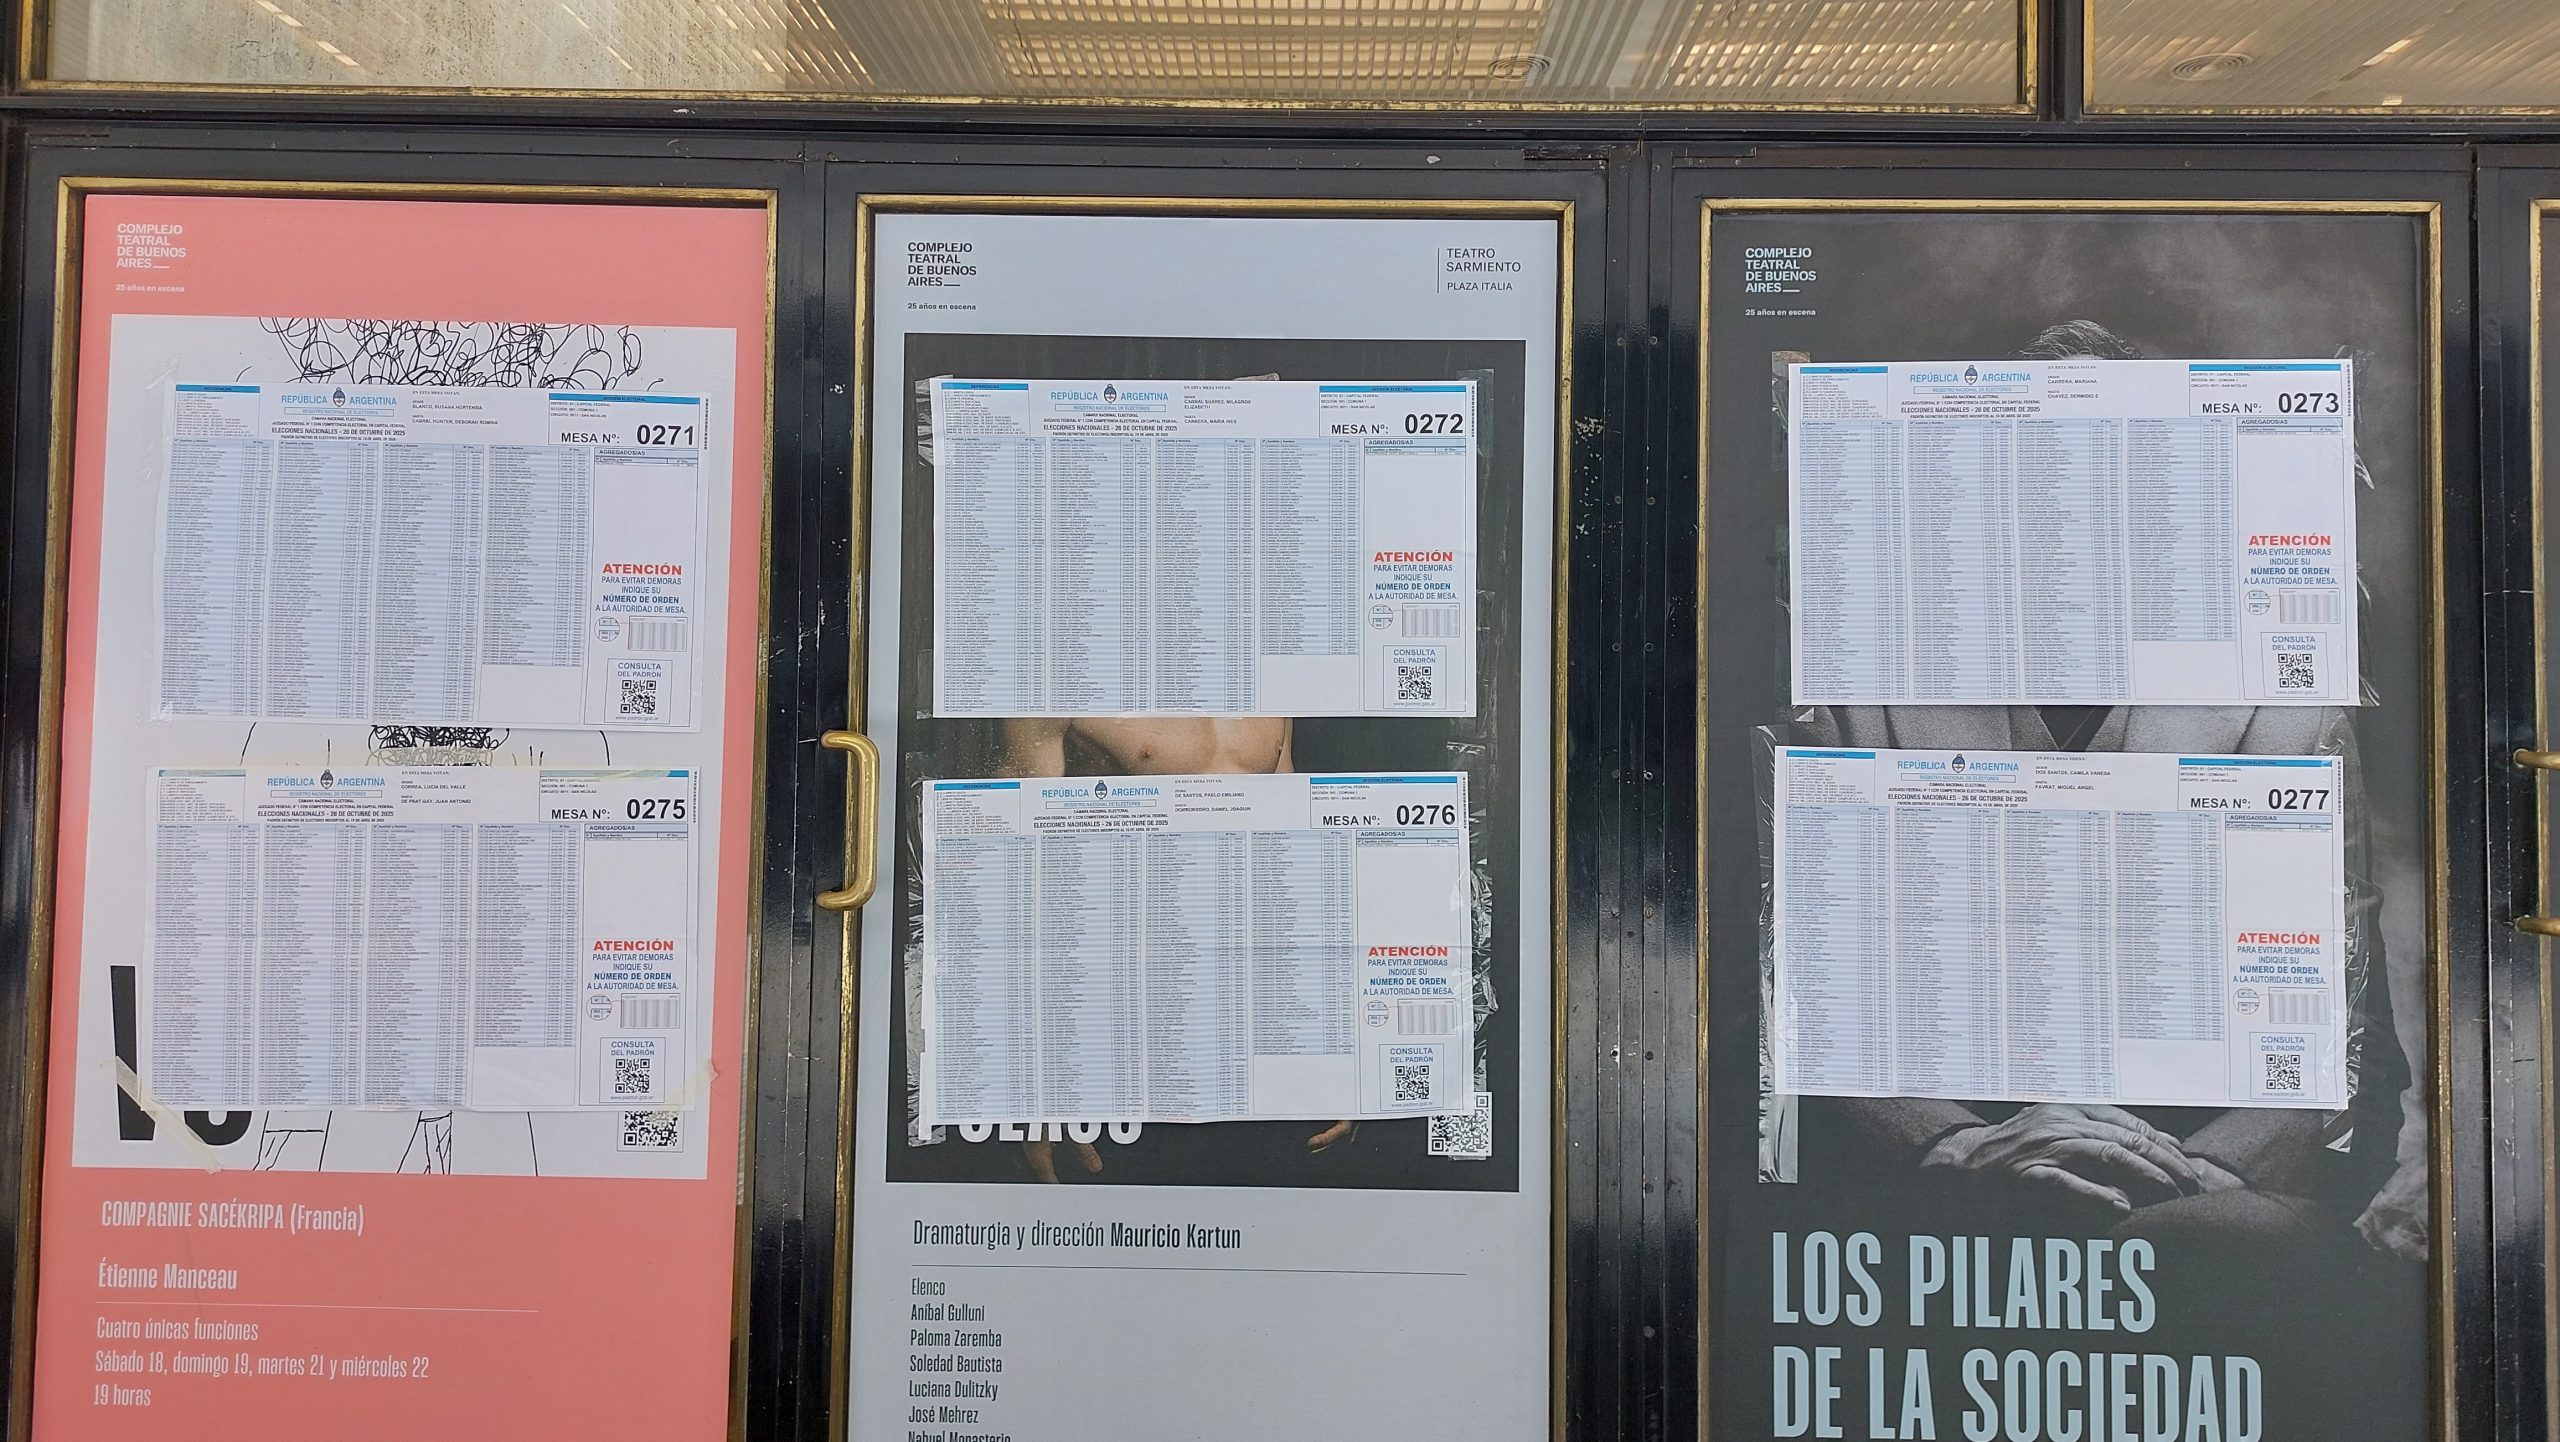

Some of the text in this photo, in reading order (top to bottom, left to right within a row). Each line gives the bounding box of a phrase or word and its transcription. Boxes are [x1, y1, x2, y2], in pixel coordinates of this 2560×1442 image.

[117, 223, 183, 235] COMPLEJO
[116, 235, 171, 246] TEATRAL
[116, 246, 186, 258] DE BUENOS
[907, 242, 973, 253] COMPLEJO
[1745, 247, 1813, 258] COMPLEJO
[907, 254, 961, 264] TEATRAL
[1446, 248, 1496, 259] TEATRO
[1446, 261, 1522, 272] SARMIENTO
[1745, 259, 1801, 270] TEATRAL
[908, 265, 977, 276] DE BUENOS
[1745, 270, 1817, 281] DE BUENOS
[1447, 282, 1513, 291] PLAZA ITALIA
[1745, 308, 1756, 316] 25
[1757, 308, 1776, 316] años
[1909, 372, 2031, 383] REPÚBLICA ARGENTINA
[281, 393, 398, 405] REPÚBLICA ARGENTINA
[1050, 390, 1169, 401] REPÚBLICA ARGENTINA
[2202, 402, 2240, 413] MESA
[2278, 392, 2340, 414] 0273
[1331, 424, 1368, 435] MESA
[1404, 413, 1464, 434] 0272
[561, 432, 598, 443] MESA
[636, 424, 694, 445] 0271
[2249, 533, 2331, 546] ATENCIÓN
[1374, 549, 1453, 562] ATENCIÓN
[602, 562, 682, 575] ATENCIÓN
[2250, 566, 2330, 575] NÚMERO DE ORDEN
[1375, 582, 1409, 590] NÚMERO
[603, 594, 637, 603] NÚMERO
[652, 596, 680, 604] ORDEN
[2271, 635, 2316, 643] CONSULTA
[2287, 643, 2316, 651] PADRÓN
[1408, 656, 1436, 664] PADRÓN
[617, 662, 662, 670] CONSULTA
[632, 670, 662, 678] PADRÓN
[1897, 759, 2020, 772] REPÚBLICA ARGENTINA
[267, 776, 386, 787] REPÚBLICA ARGENTINA
[1041, 787, 1160, 798] REPÚBLICA ARGENTINA
[1888, 793, 1920, 801] ELECCIONES
[2190, 798, 2229, 809] MESA
[2268, 788, 2330, 811] 0277
[551, 808, 589, 820] MESA
[626, 798, 686, 820] 0275
[1322, 815, 1359, 826] MESA
[1396, 804, 1456, 826] 0276
[2237, 931, 2320, 944] ATENCIÓN
[593, 938, 674, 951] ATENCIÓN
[1368, 945, 1448, 957] ATENCIÓN
[2239, 964, 2319, 974] NÚMERO DE ORDEN
[593, 971, 672, 980] NÚMERO DE ORDEN
[1369, 976, 1404, 985] NÚMERO
[611, 1040, 655, 1048] CONSULTA
[2260, 1036, 2305, 1044] CONSULTA
[626, 1048, 655, 1056] PADRÓN
[1389, 1047, 1433, 1055] CONSULTA
[2276, 1044, 2305, 1052] PADRÓN
[1405, 1055, 1433, 1063] PADRÓN
[101, 1197, 365, 1237] COMPAGNIE SACÉKRIPA (Francia)
[913, 1219, 1241, 1251] Dramaturgia y dirección Mauricio Kartun
[98, 1256, 238, 1291] Étienne Manceau
[911, 1277, 946, 1296] Elenco
[1772, 1230, 2156, 1334] LOS PILARES
[910, 1302, 985, 1322] Aníbal Gulluni
[96, 1316, 259, 1342] Cuatro únicas funciones
[910, 1328, 1002, 1348] Paloma Zaremba
[95, 1350, 429, 1380] Sábado 18, domingo 19, martes 21 y miércoles 22
[909, 1353, 1003, 1373] Soledad Bautista
[93, 1383, 151, 1407] 19 horas
[909, 1379, 999, 1401] Luciana Dulitzky
[1772, 1345, 2264, 1442] DE LA SOCIEDAD
[908, 1404, 979, 1424] José Mehrez
